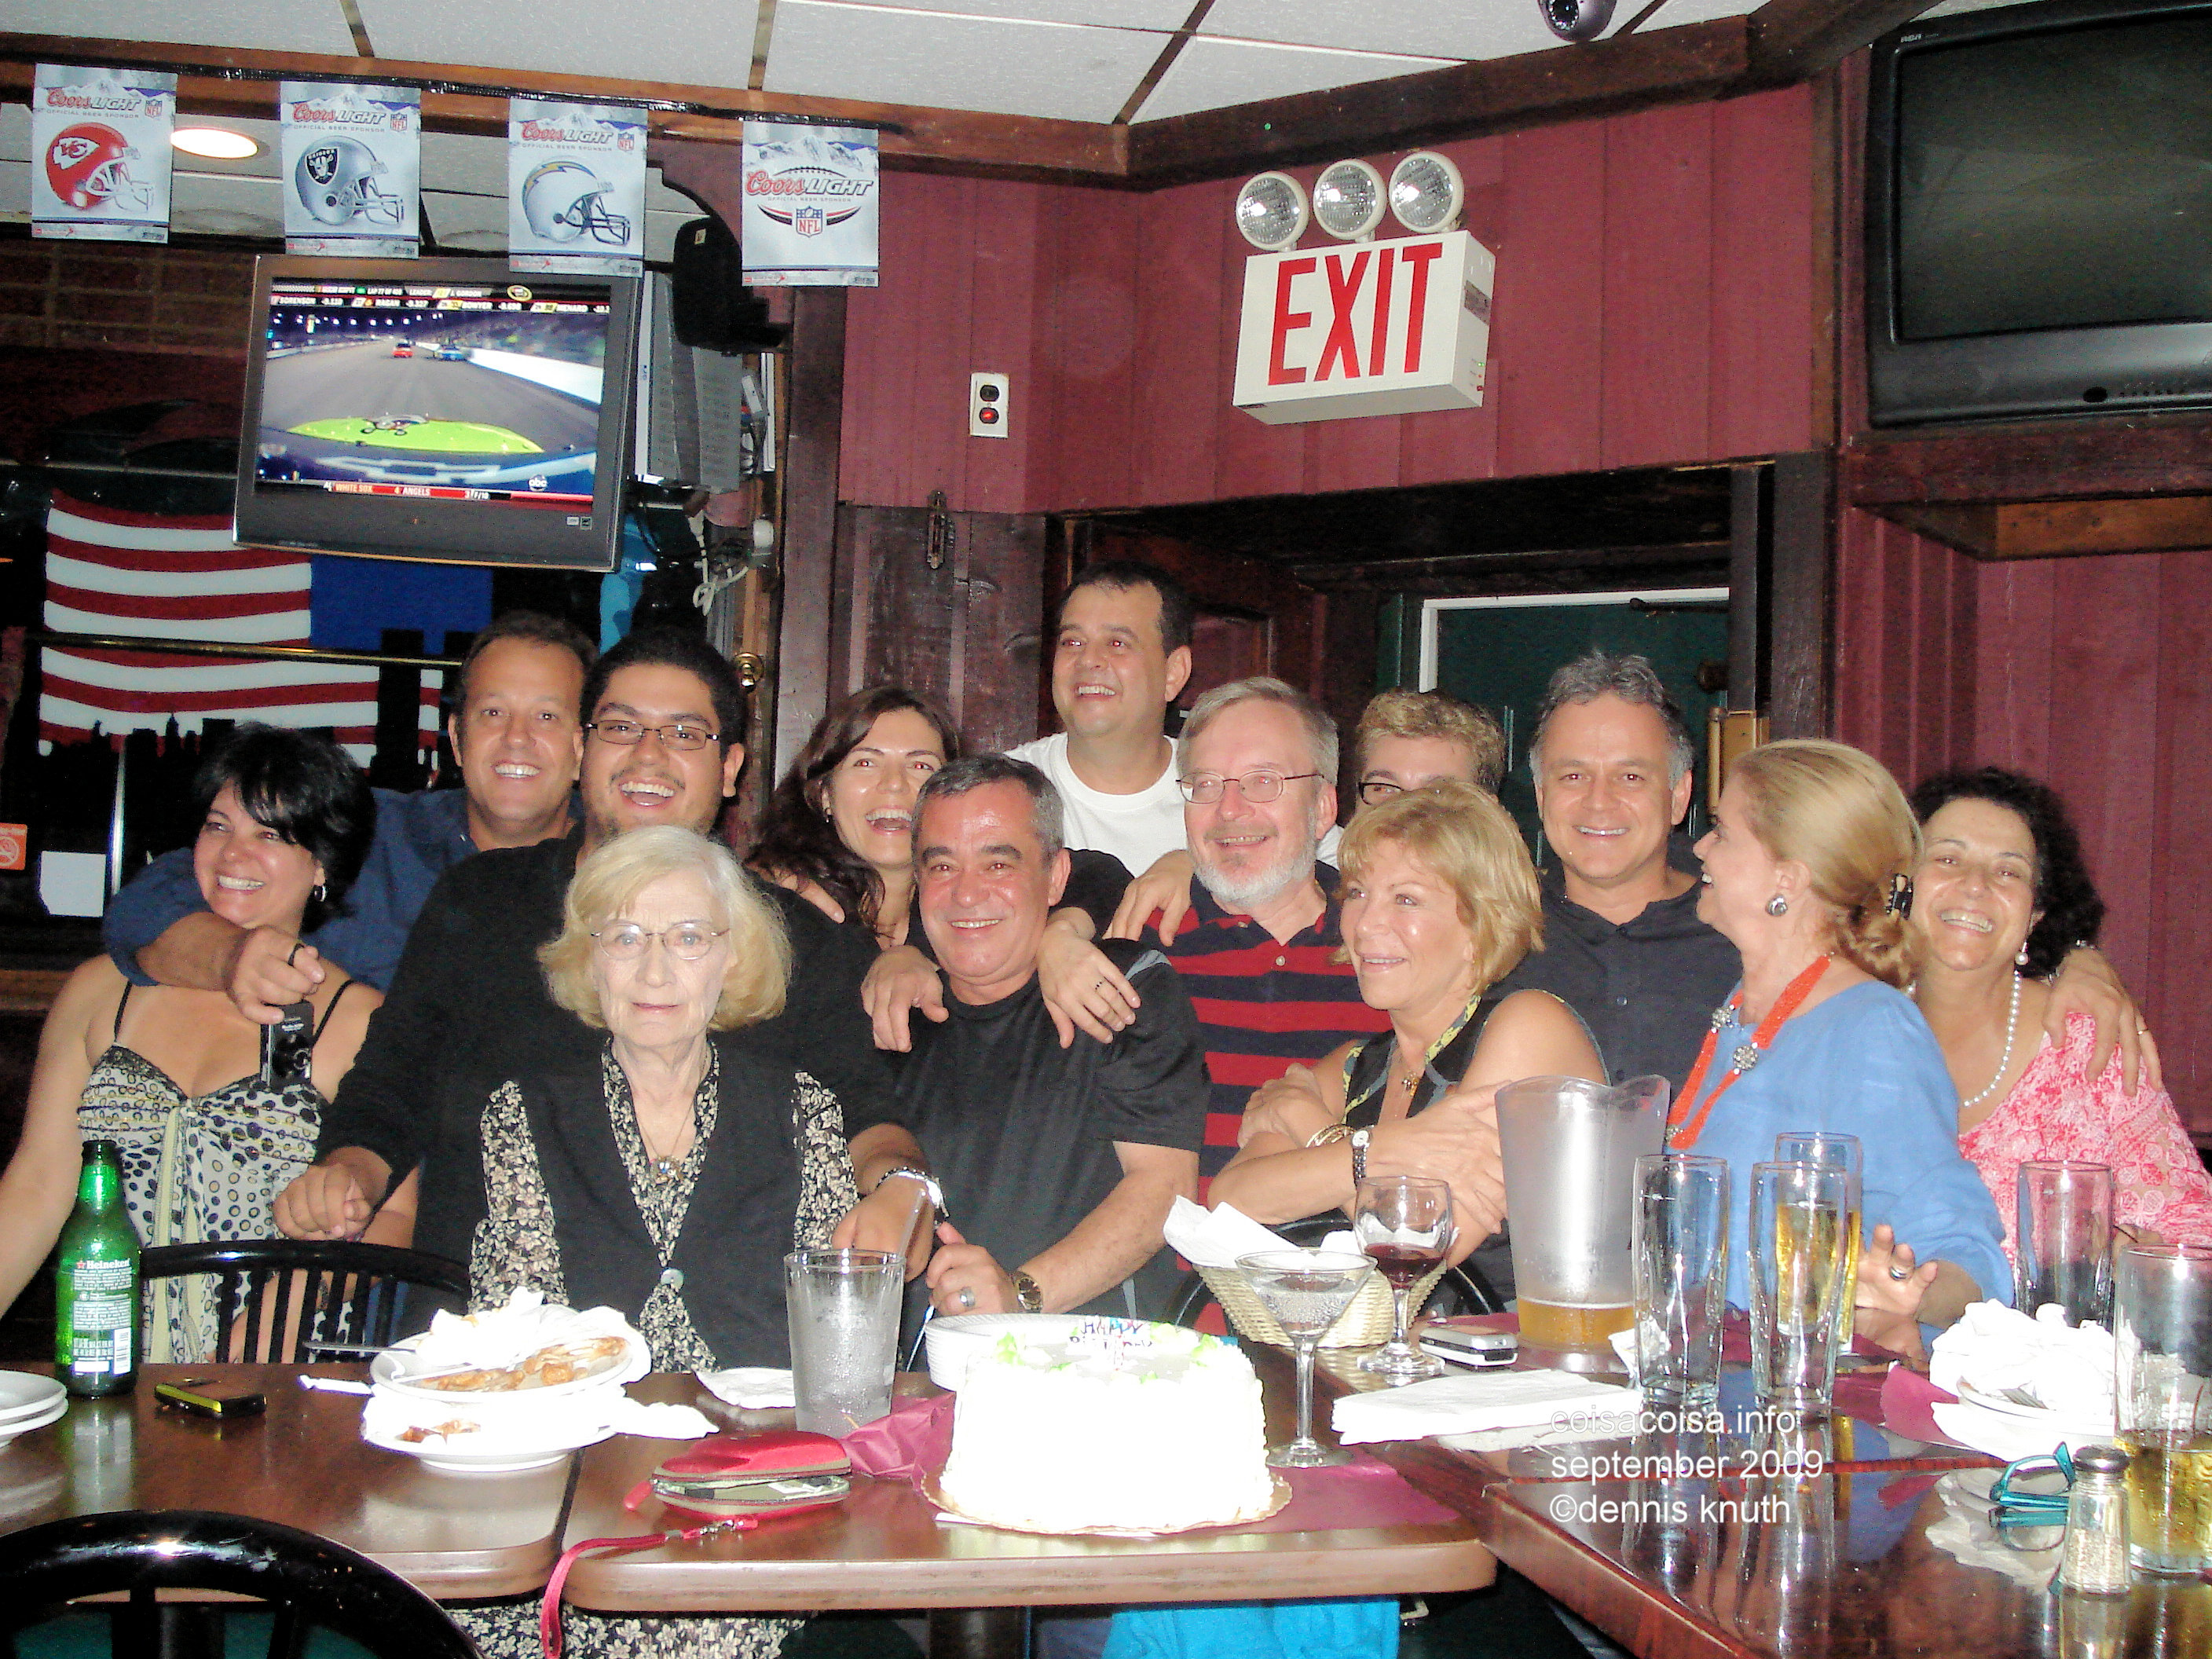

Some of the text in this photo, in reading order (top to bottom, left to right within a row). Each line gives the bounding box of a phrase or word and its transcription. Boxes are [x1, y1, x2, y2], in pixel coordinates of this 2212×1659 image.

[47, 88, 141, 111] Coors LIGHT
[146, 105, 161, 117] NFL
[293, 103, 386, 125] Coors LIGHT
[392, 119, 406, 129] NFL
[522, 122, 614, 144] Coors LIGHT
[619, 139, 632, 150] NFL
[746, 170, 873, 196] Coors LIGHT
[799, 219, 820, 233] NFL
[1268, 243, 1443, 386] EXIT
[335, 484, 357, 493] WHITE
[358, 485, 374, 493] SOX
[529, 478, 548, 488] abc
[402, 486, 471, 499] ANGELS 3
[474, 491, 489, 500] F/10
[86, 1258, 130, 1269] Heineken
[1082, 1316, 1144, 1335] HAPPY
